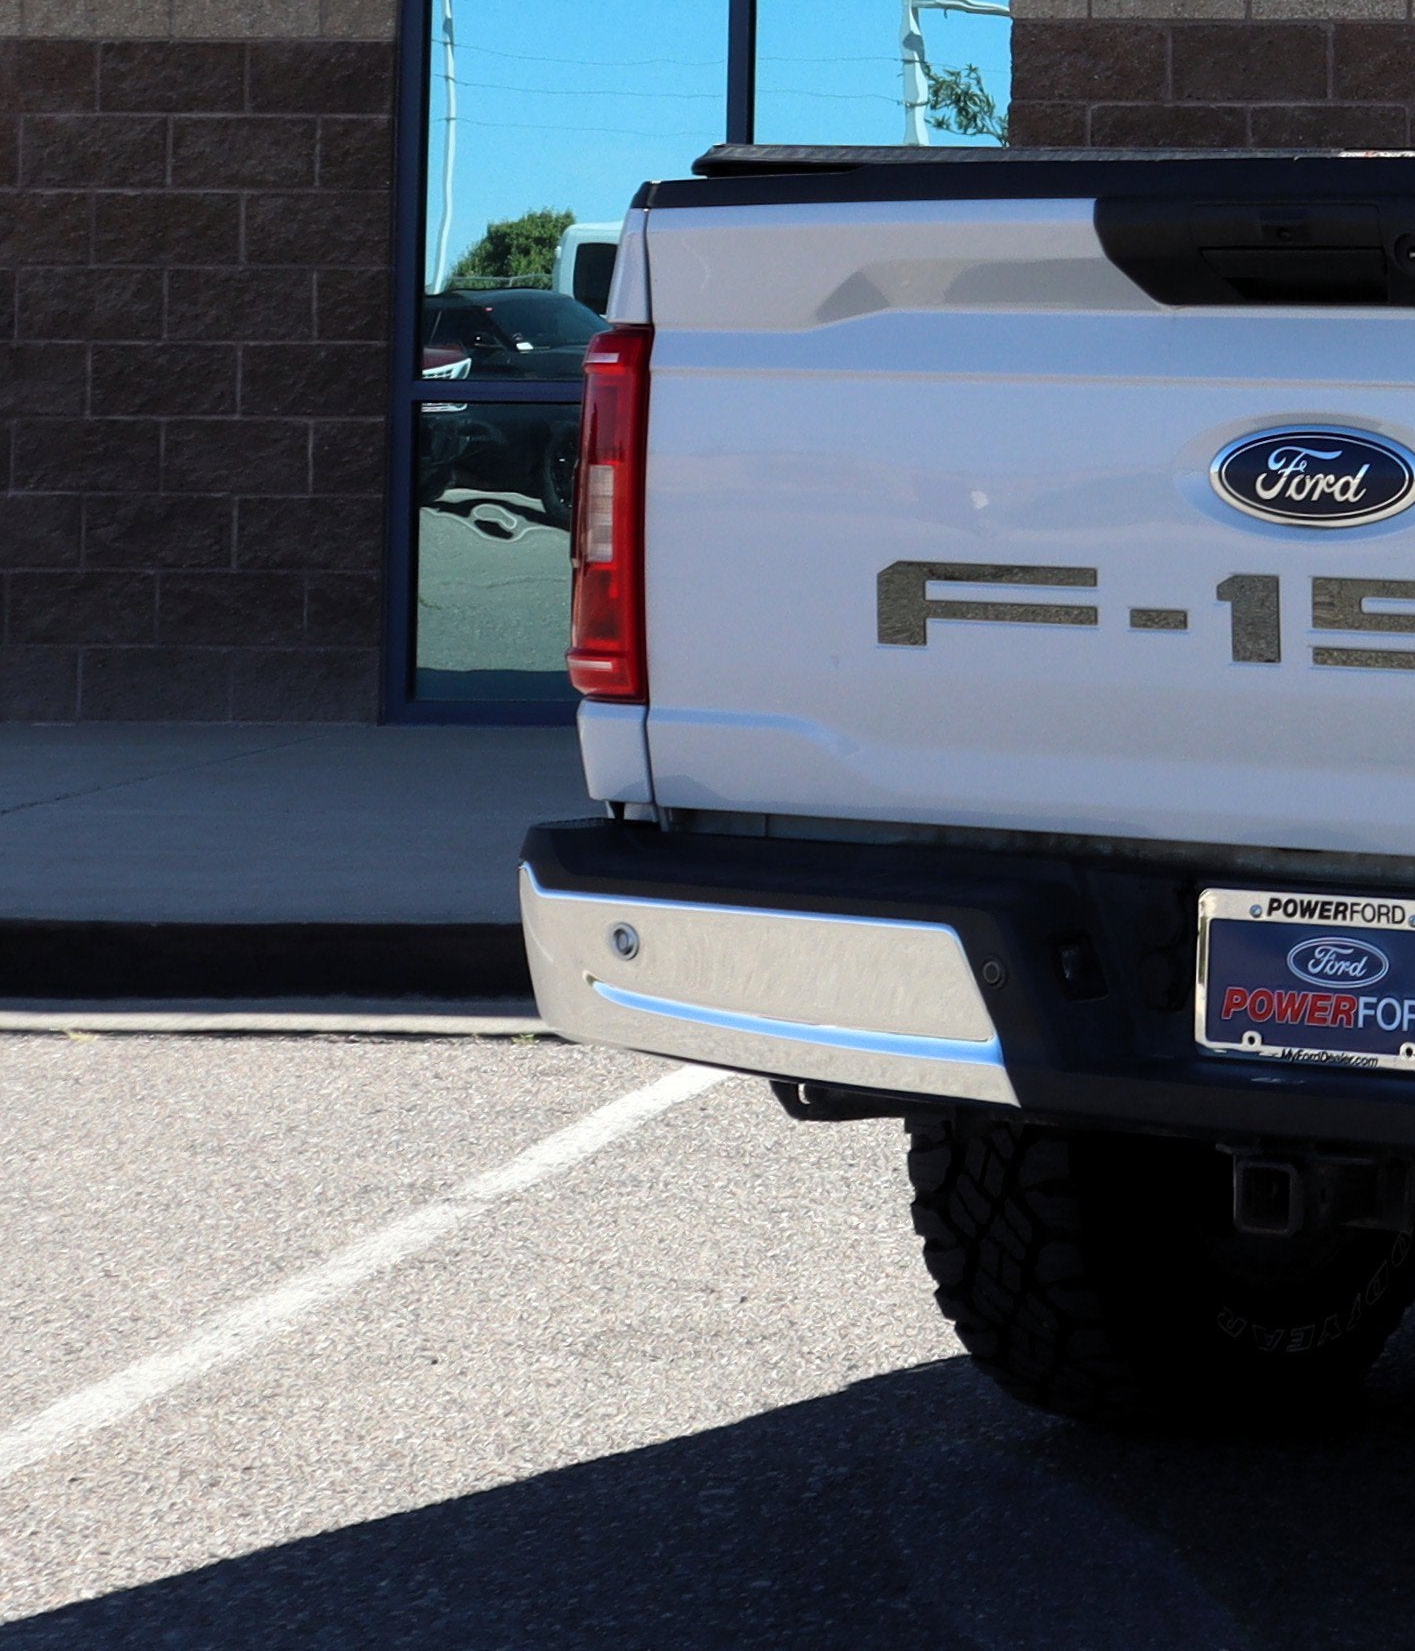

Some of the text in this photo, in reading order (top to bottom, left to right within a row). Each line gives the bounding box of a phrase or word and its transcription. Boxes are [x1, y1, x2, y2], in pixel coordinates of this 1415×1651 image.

[1254, 447, 1371, 505] Ford
[1267, 897, 1406, 926] POWERFORD
[1306, 946, 1369, 978] Ford
